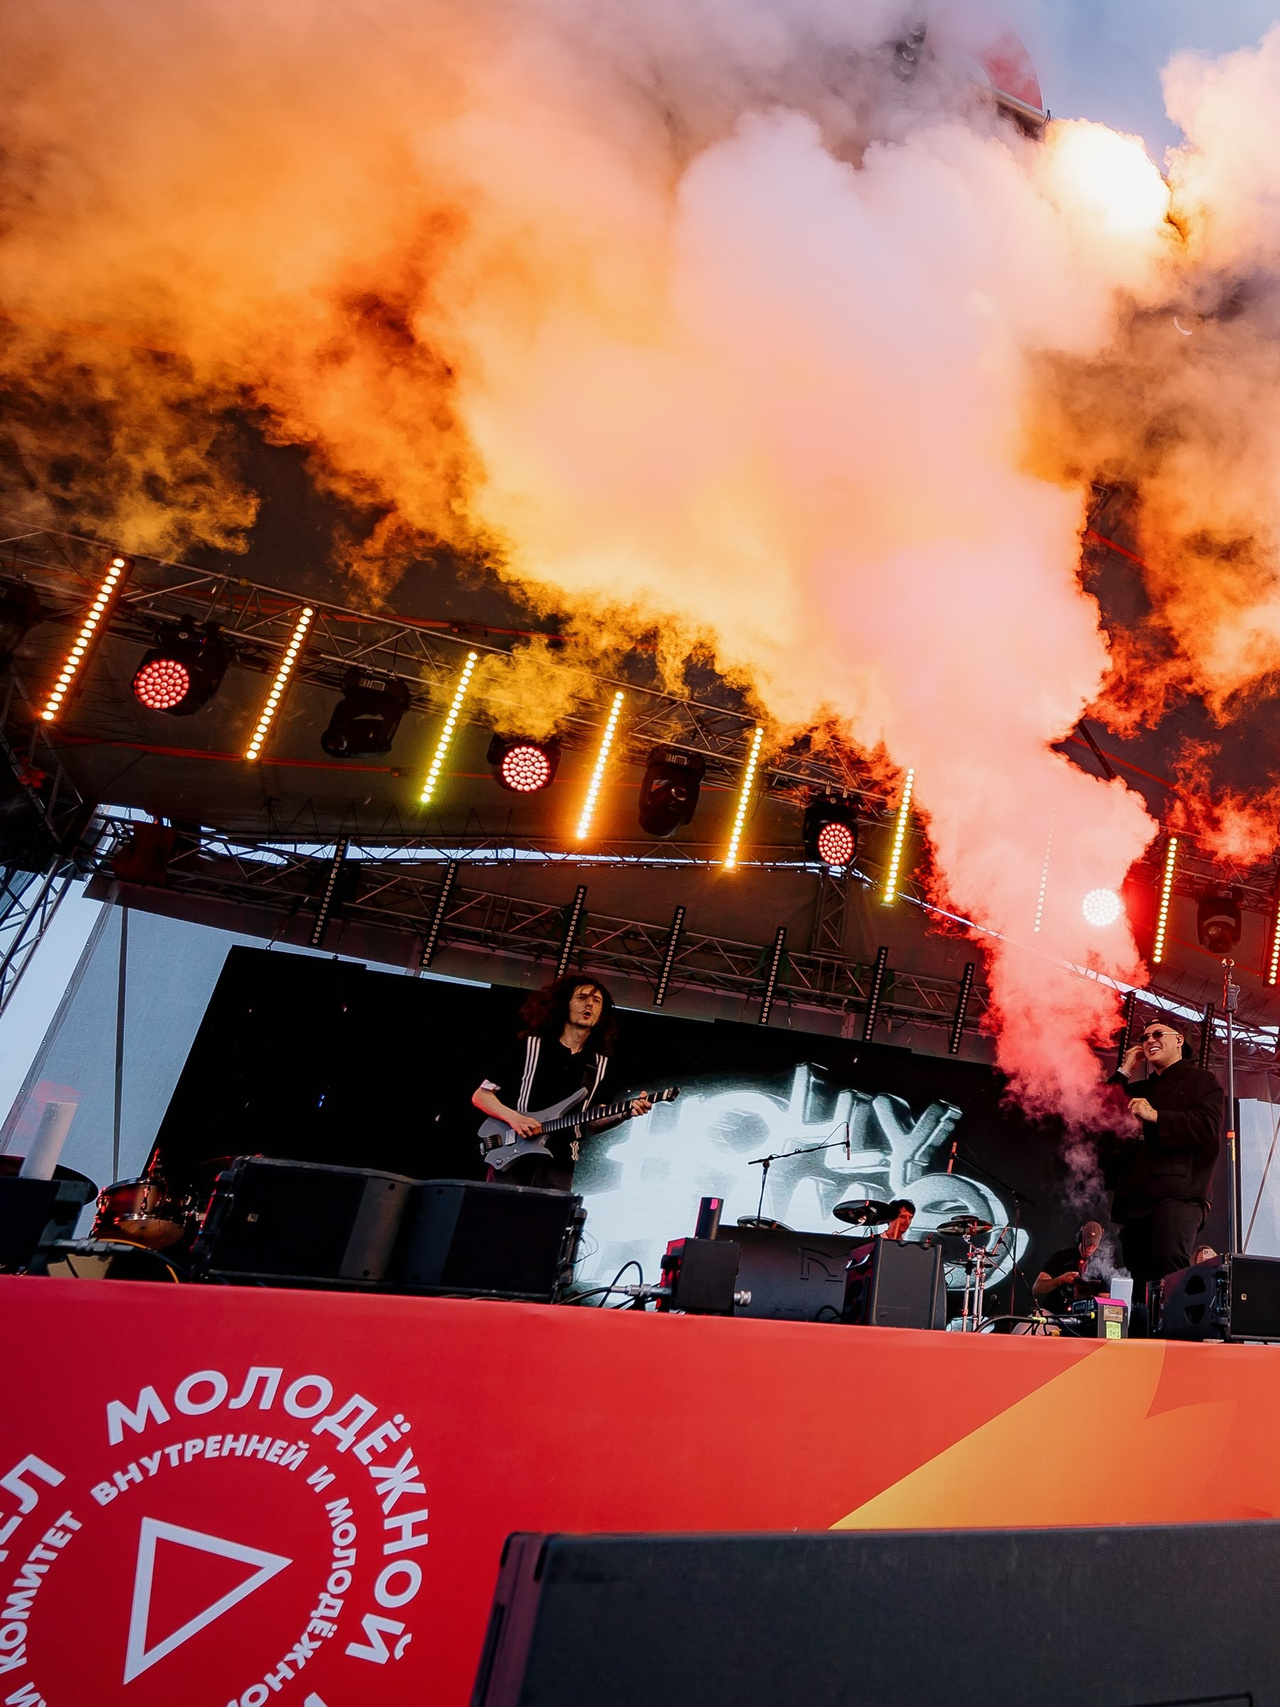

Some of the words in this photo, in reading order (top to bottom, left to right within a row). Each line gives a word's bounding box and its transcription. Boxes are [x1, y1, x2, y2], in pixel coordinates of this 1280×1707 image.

[90, 1434, 310, 1506] ВНУТРЕННЕЙ
[106, 1366, 429, 1665] МОЛОДЁЖНОЙ
[306, 1465, 336, 1493] И
[0, 1510, 83, 1674] КОМИТЕТ
[226, 1497, 357, 1707] МОЛОДЁЖНО
